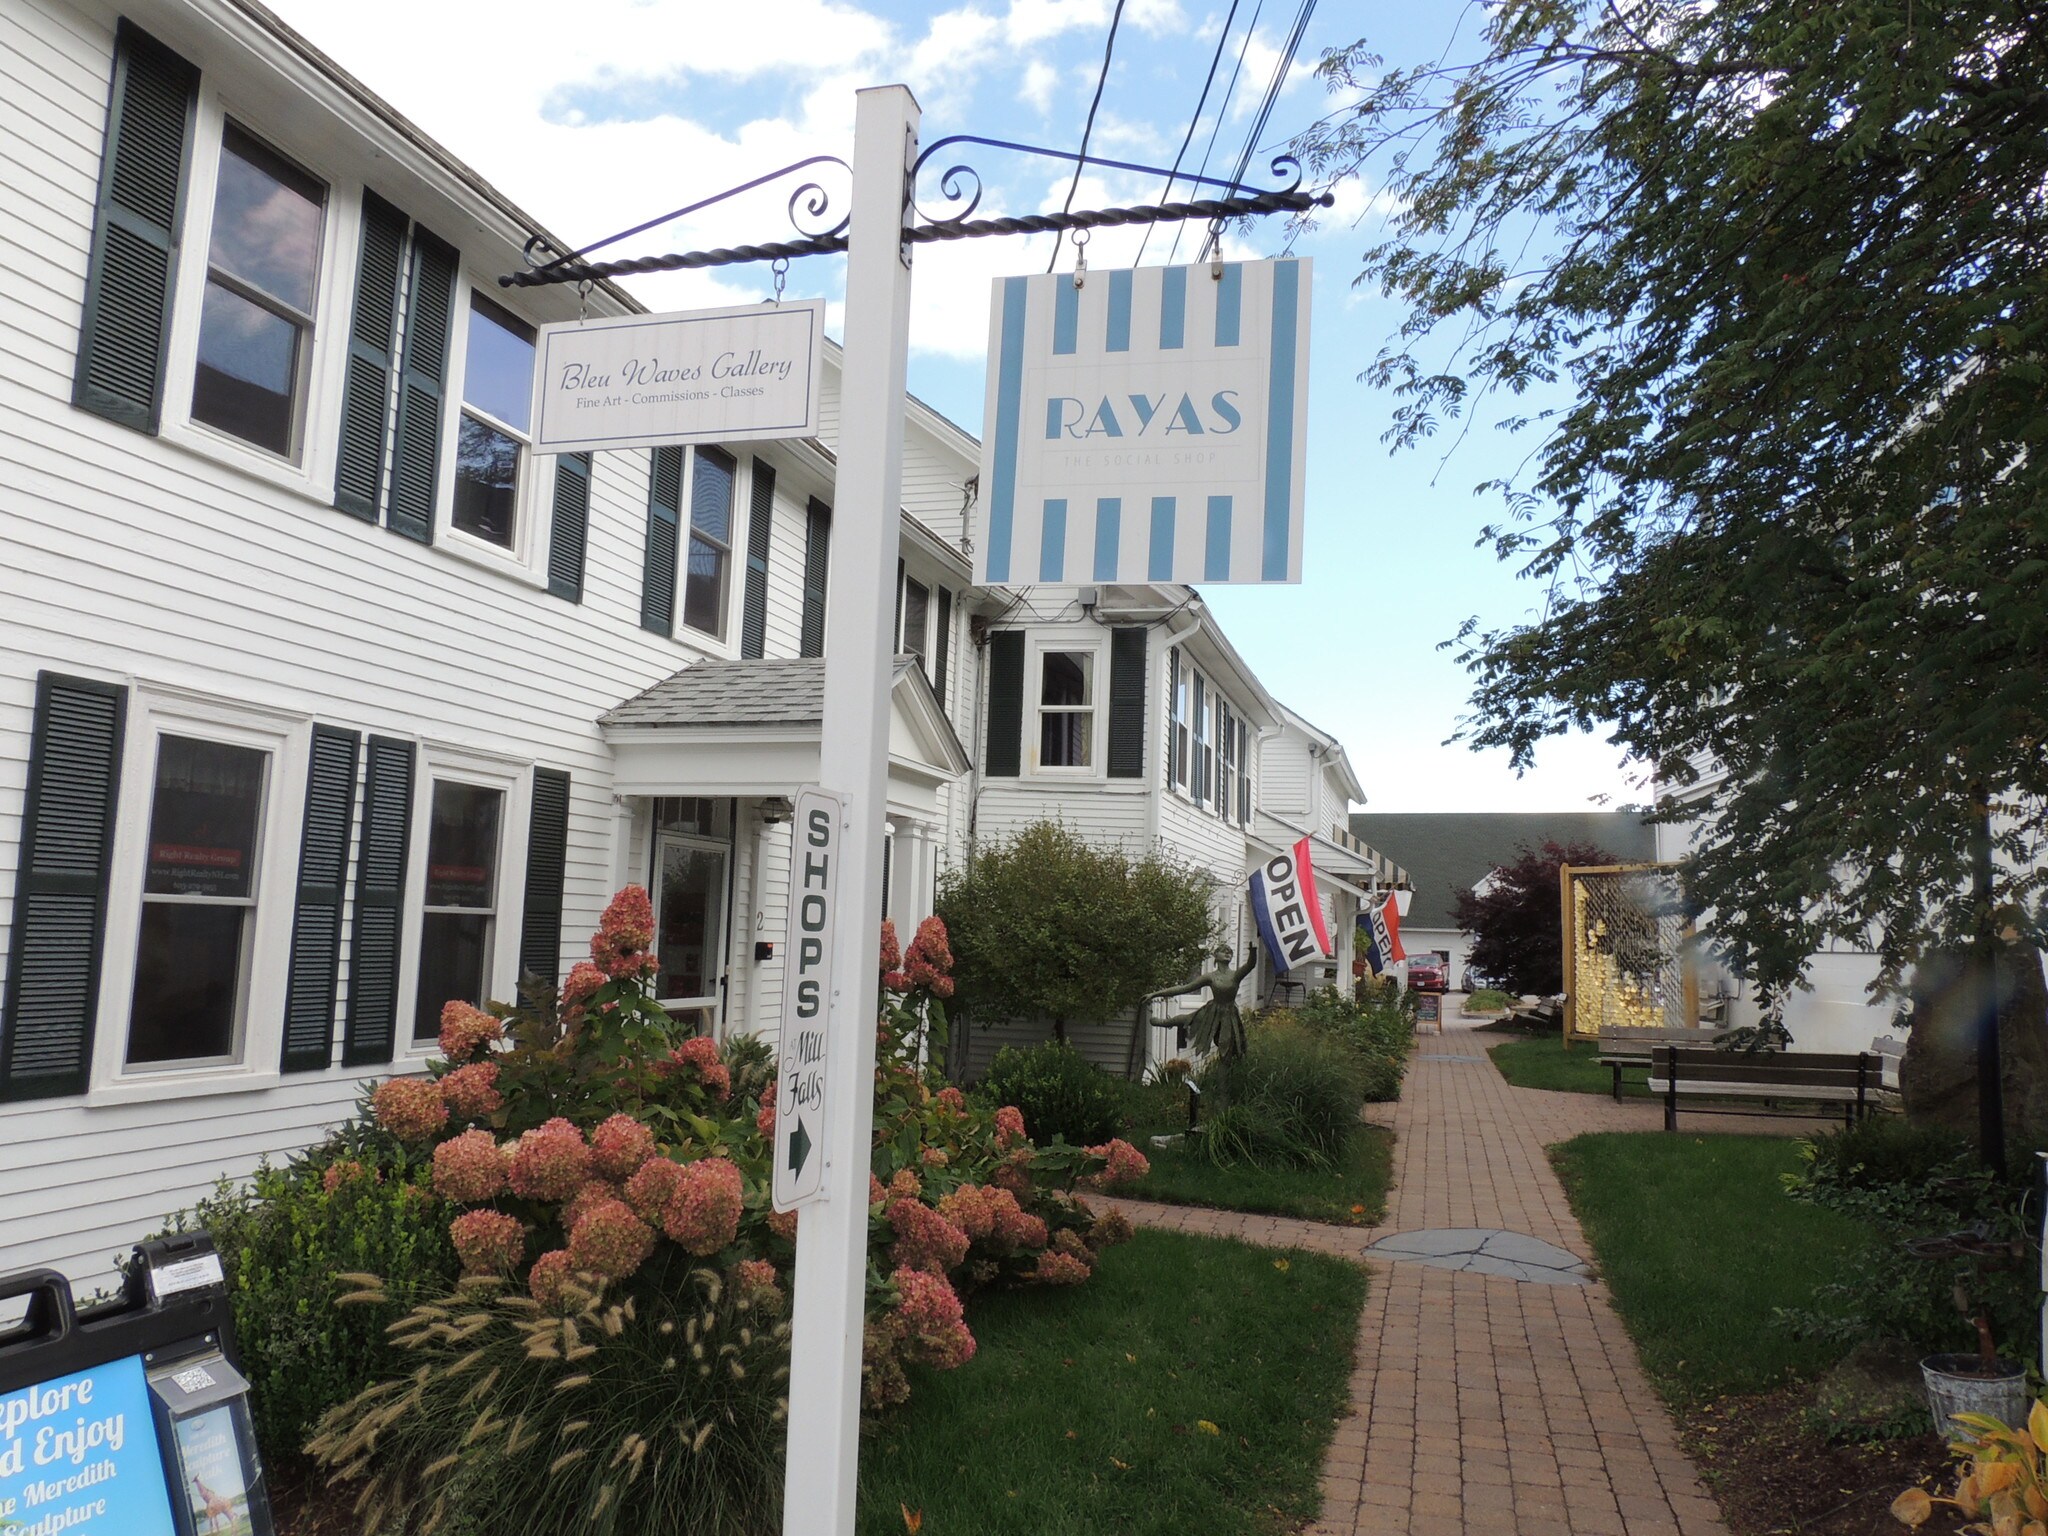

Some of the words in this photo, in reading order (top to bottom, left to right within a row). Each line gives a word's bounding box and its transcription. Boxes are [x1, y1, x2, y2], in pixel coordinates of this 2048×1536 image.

[560, 361, 611, 391] Bleu
[622, 358, 702, 387] Waves
[711, 349, 793, 381] Gallery
[576, 397, 600, 409] Fine
[603, 395, 622, 407] Art
[632, 388, 710, 405] Commissions
[720, 385, 764, 399] Classes
[1045, 390, 1242, 440] RAYAS
[1064, 456, 1092, 468] THE
[1103, 454, 1162, 466] SOCIAL
[1173, 452, 1217, 465] SHOP
[756, 911, 764, 931] 2
[797, 809, 831, 1019] SHOPS
[1266, 855, 1316, 964] OPEN
[784, 1030, 826, 1074] Mill
[783, 1070, 824, 1117] Falls
[33, 1413, 124, 1465] Enjoy
[23, 1458, 117, 1508] Meredith
